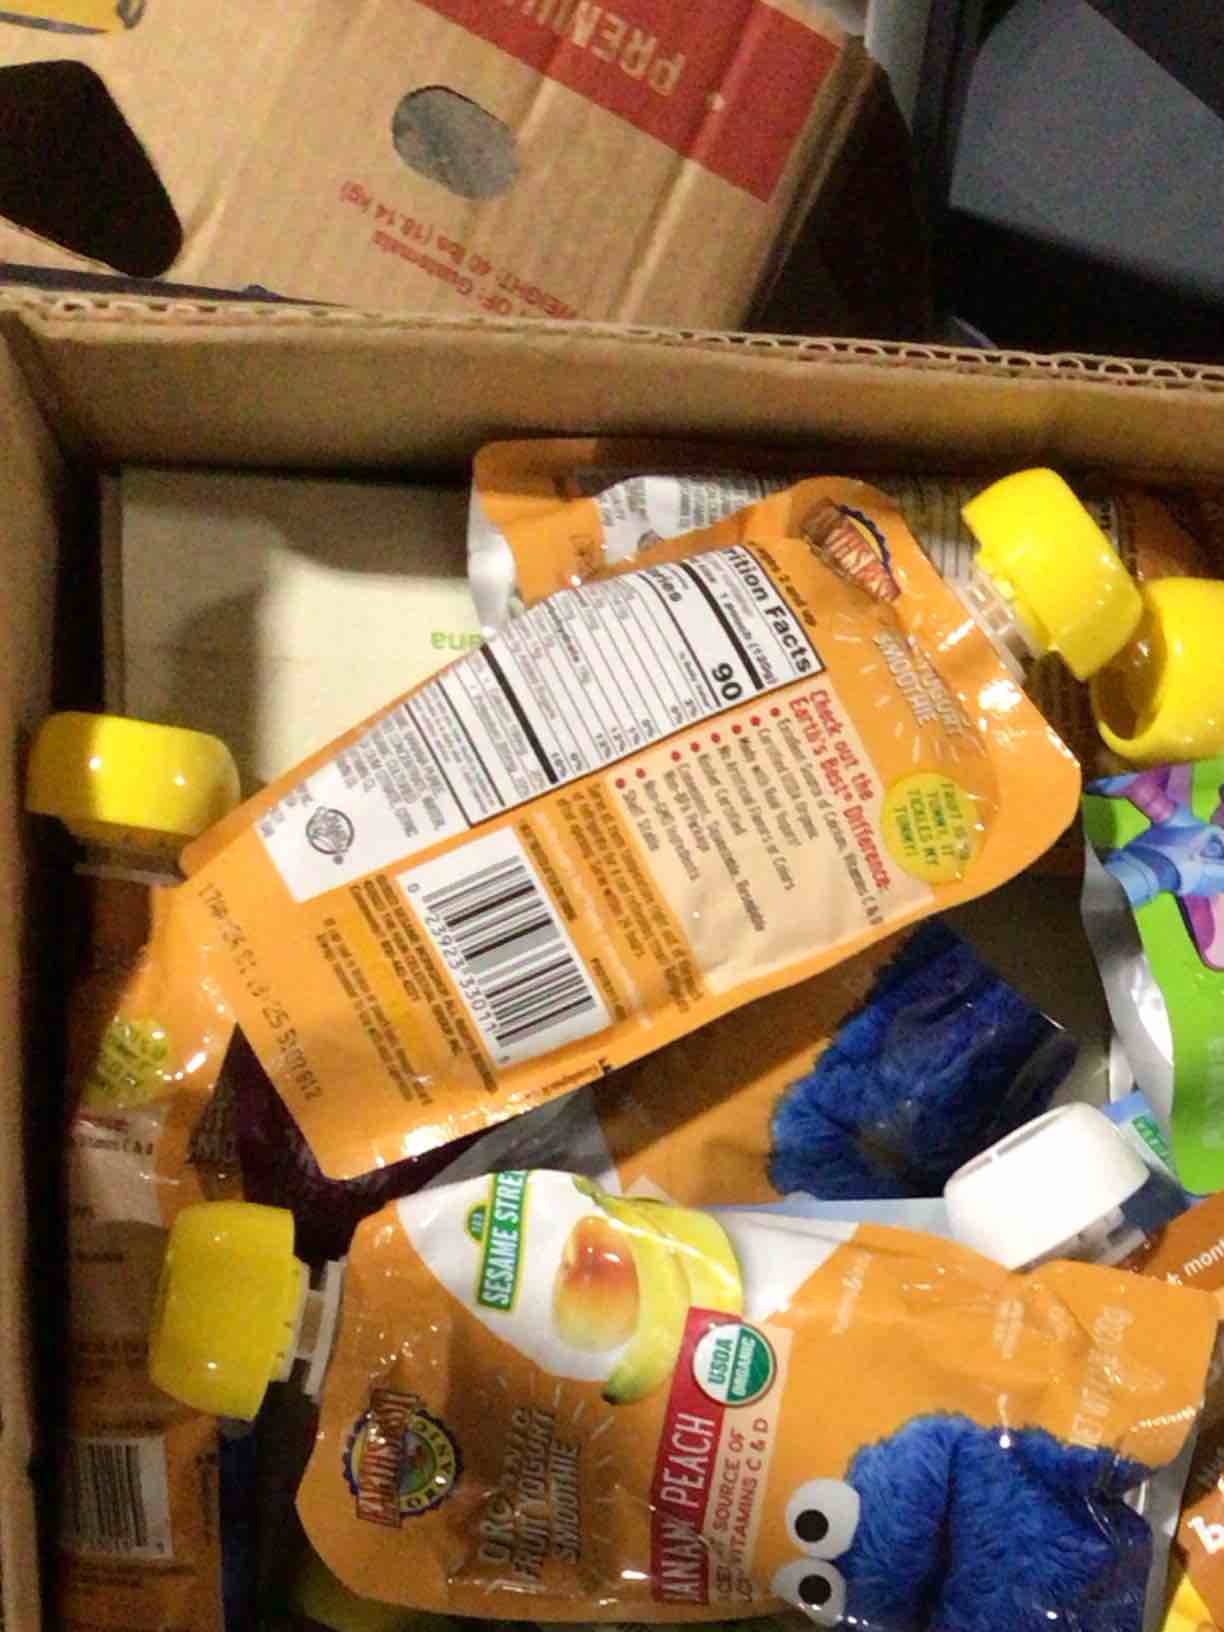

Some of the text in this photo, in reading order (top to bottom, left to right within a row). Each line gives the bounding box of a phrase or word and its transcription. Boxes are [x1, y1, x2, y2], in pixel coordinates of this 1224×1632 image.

[708, 659, 745, 705] 90
[763, 602, 815, 675] Facts
[788, 694, 897, 893] Earth's Difference:
[809, 687, 876, 801] Check out the
[424, 912, 465, 971] 23923
[456, 974, 500, 1036] 33011
[483, 1227, 519, 1304] SESAME
[706, 1336, 733, 1385] USDA
[731, 1335, 755, 1397] ORGANIC
[550, 1443, 582, 1563] SMOOTHIE
[664, 1412, 715, 1508] PEACH
[712, 1426, 746, 1532] SOURCE OF
[725, 1416, 770, 1567] VITAMINS C & D
